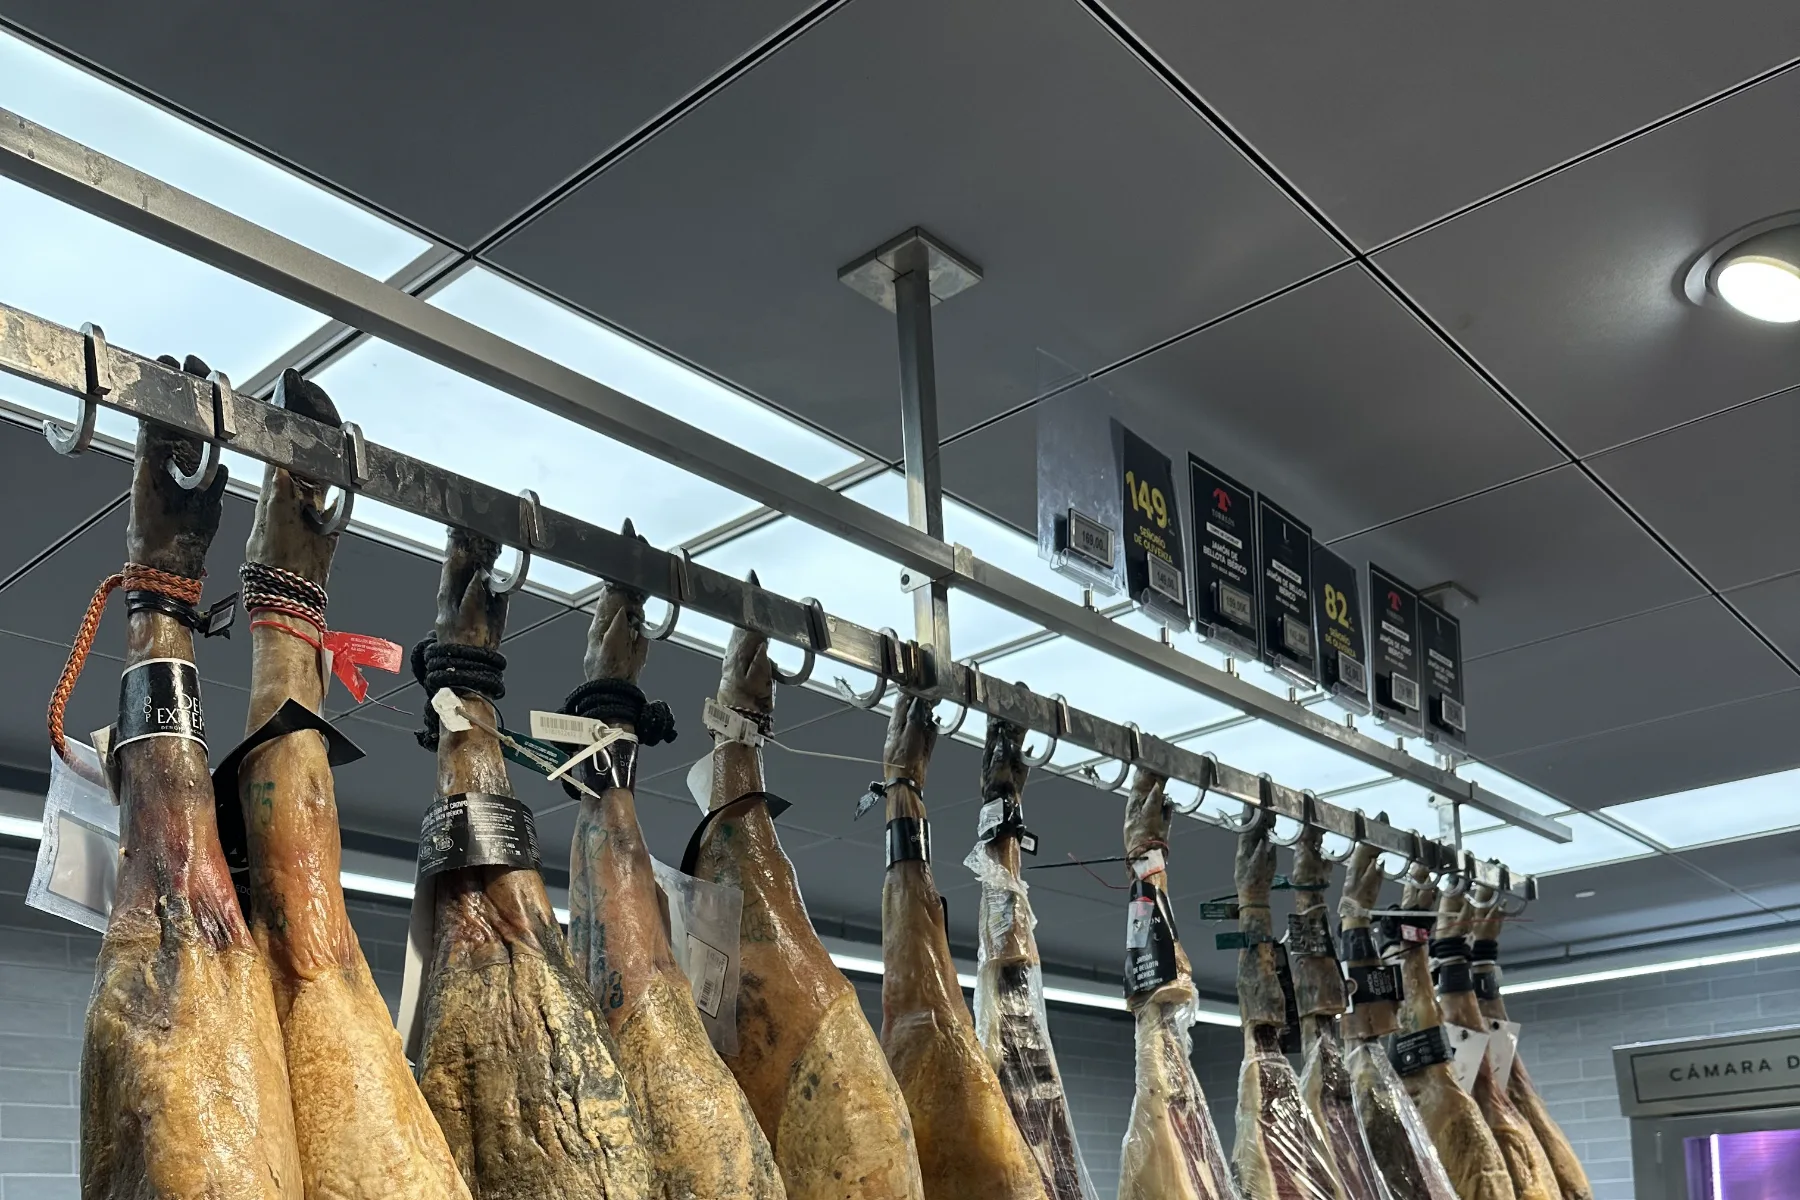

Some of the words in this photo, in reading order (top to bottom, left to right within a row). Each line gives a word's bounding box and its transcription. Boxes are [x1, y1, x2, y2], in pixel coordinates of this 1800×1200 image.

[1126, 471, 1167, 528] 149
[1325, 583, 1349, 628] 82
[1670, 1058, 1771, 1082] CÁMARA
